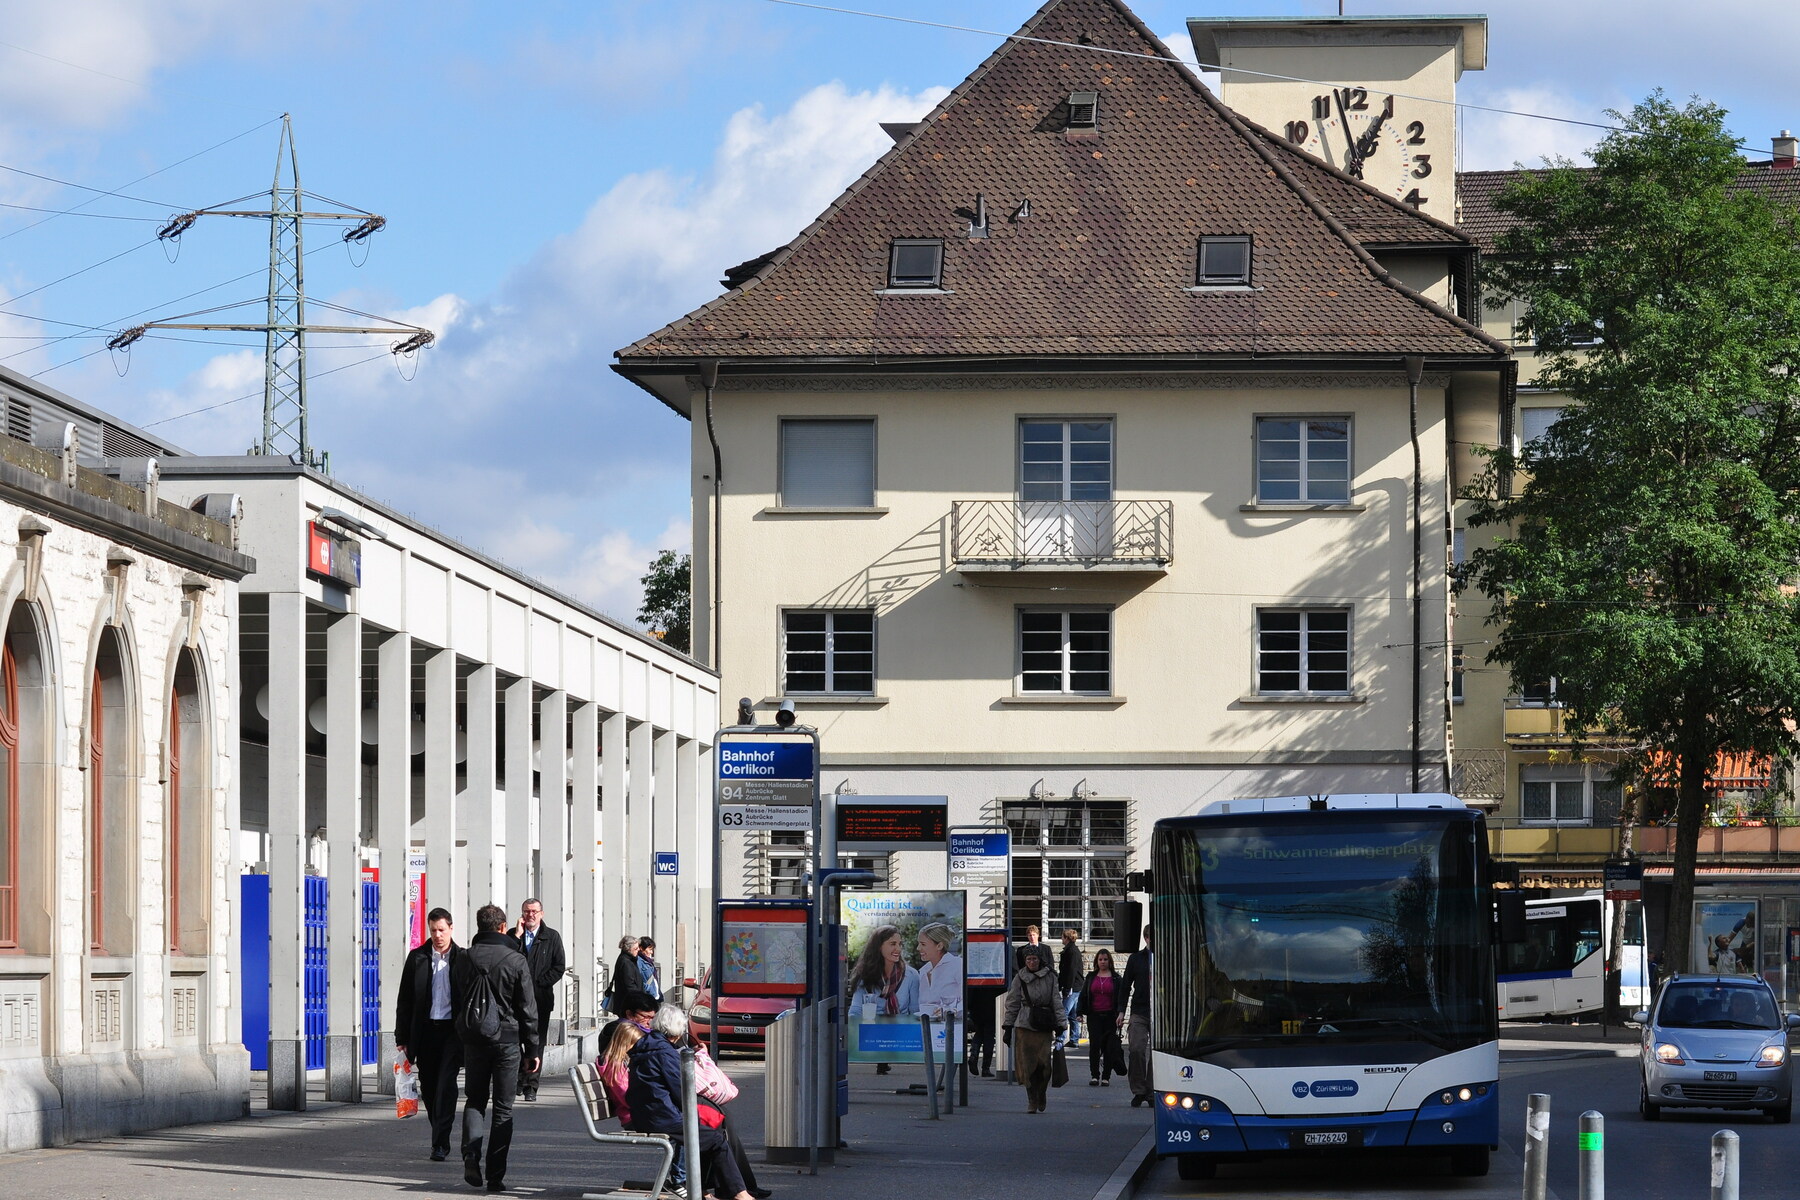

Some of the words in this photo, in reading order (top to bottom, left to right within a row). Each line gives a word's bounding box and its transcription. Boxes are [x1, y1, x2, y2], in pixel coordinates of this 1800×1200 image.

[1341, 86, 1369, 111] 12
[1313, 95, 1330, 119] 11
[1286, 120, 1309, 143] 10
[1408, 120, 1426, 144] 2
[1413, 154, 1432, 179] 3
[1404, 188, 1428, 211] 4
[722, 750, 775, 762] Bahnhof
[722, 763, 775, 775] Oerlikon
[722, 786, 743, 800] 94
[722, 812, 743, 826] 63
[952, 846, 985, 854] Oerlikon
[1243, 843, 1435, 860] Schwamendingerplatz
[658, 862, 675, 871] WC
[952, 860, 966, 869] 63
[952, 876, 966, 885] 94
[847, 898, 895, 912] Qualität
[1363, 1066, 1408, 1074] NEOPLAN
[1316, 1085, 1329, 1093] Züri
[1167, 1130, 1192, 1143] 249
